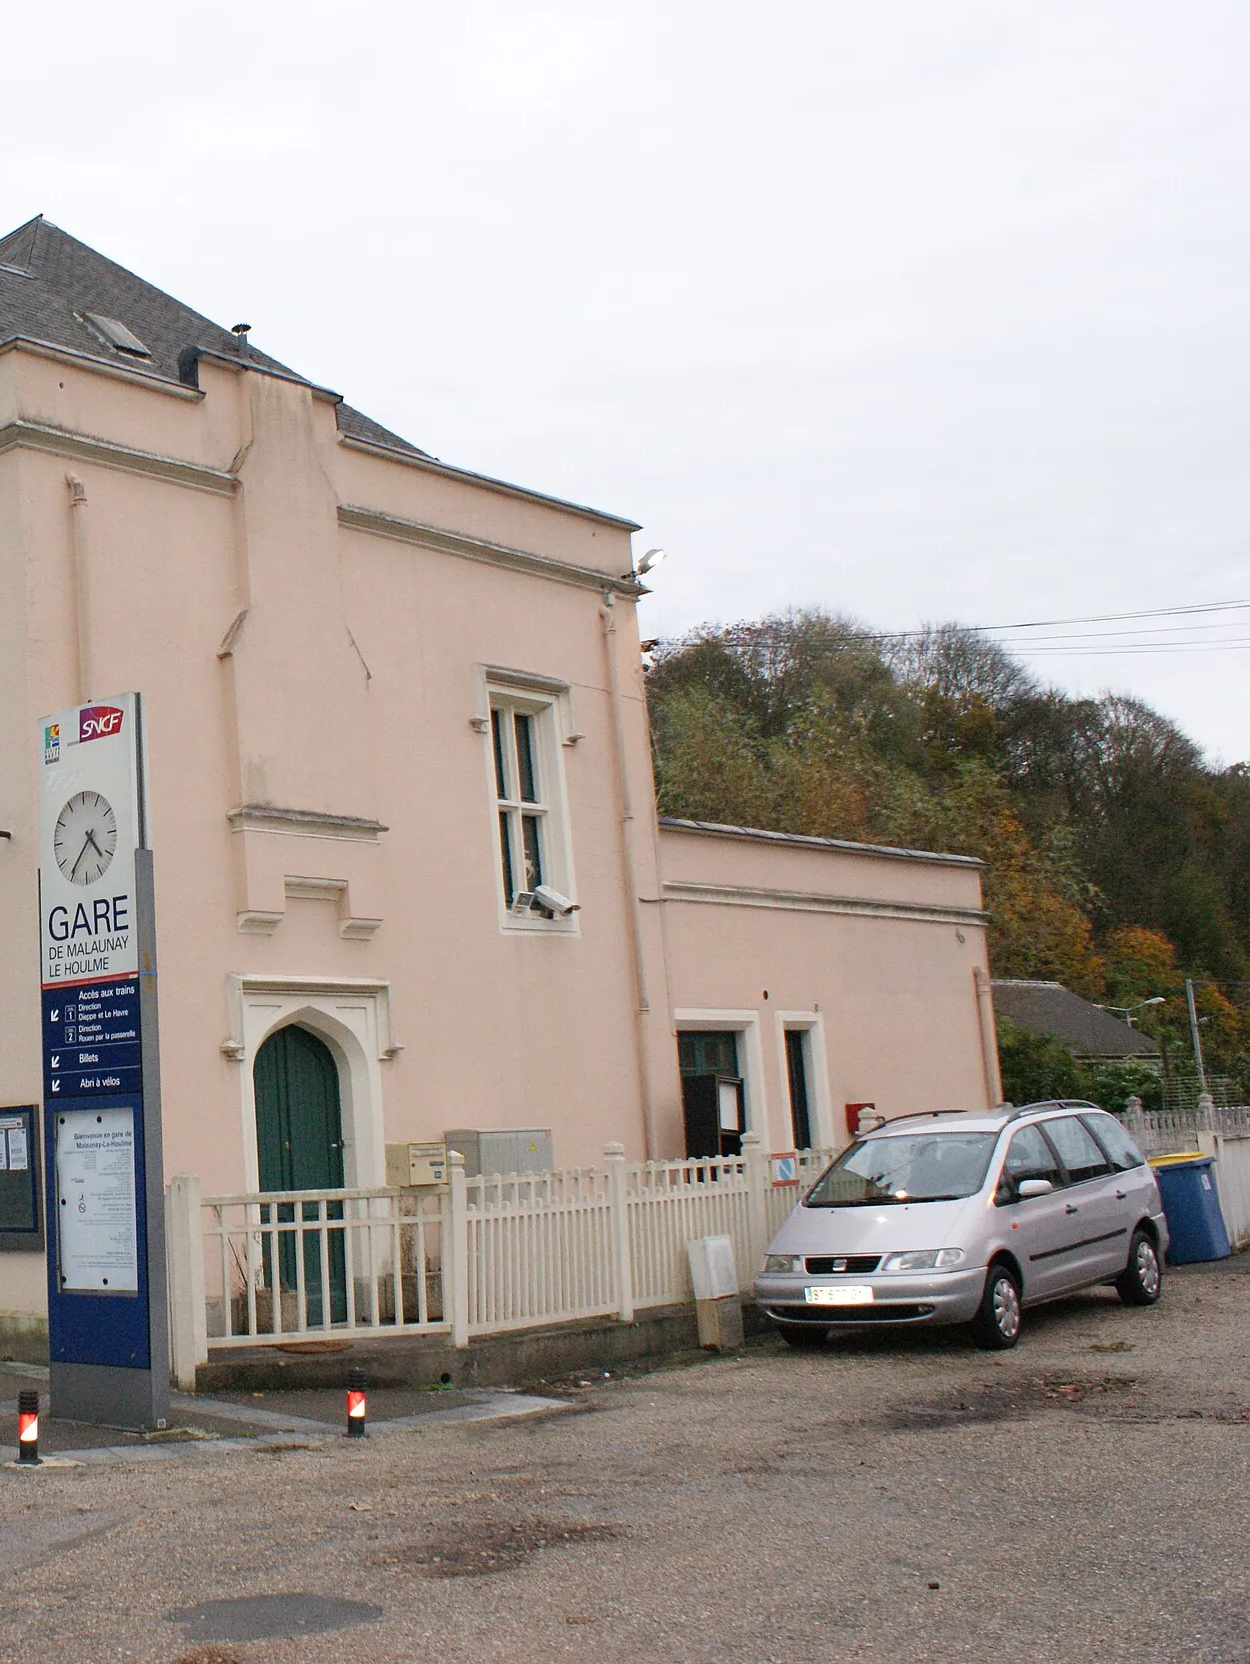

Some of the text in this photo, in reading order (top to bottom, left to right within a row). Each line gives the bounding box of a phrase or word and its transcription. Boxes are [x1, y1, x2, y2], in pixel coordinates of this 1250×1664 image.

[81, 712, 121, 738] SNCF
[48, 895, 129, 941] GARE
[49, 936, 129, 960] DE MALAUNAY
[49, 957, 109, 977] LE HOULME
[79, 985, 135, 1000] Accès aux trains
[78, 1002, 101, 1011] Direction
[69, 1012, 73, 1020] 1
[78, 1009, 129, 1022] Dieppe et Le Havre
[78, 1024, 102, 1033] Direction
[68, 1033, 73, 1041] 2
[78, 1034, 95, 1042] Rouen
[111, 1030, 136, 1040] passerelle
[79, 1053, 99, 1064] Billets
[80, 1077, 95, 1088] Abri
[102, 1076, 120, 1087] vélos
[74, 1132, 103, 1140] Bienvenue
[111, 1131, 124, 1140] gare
